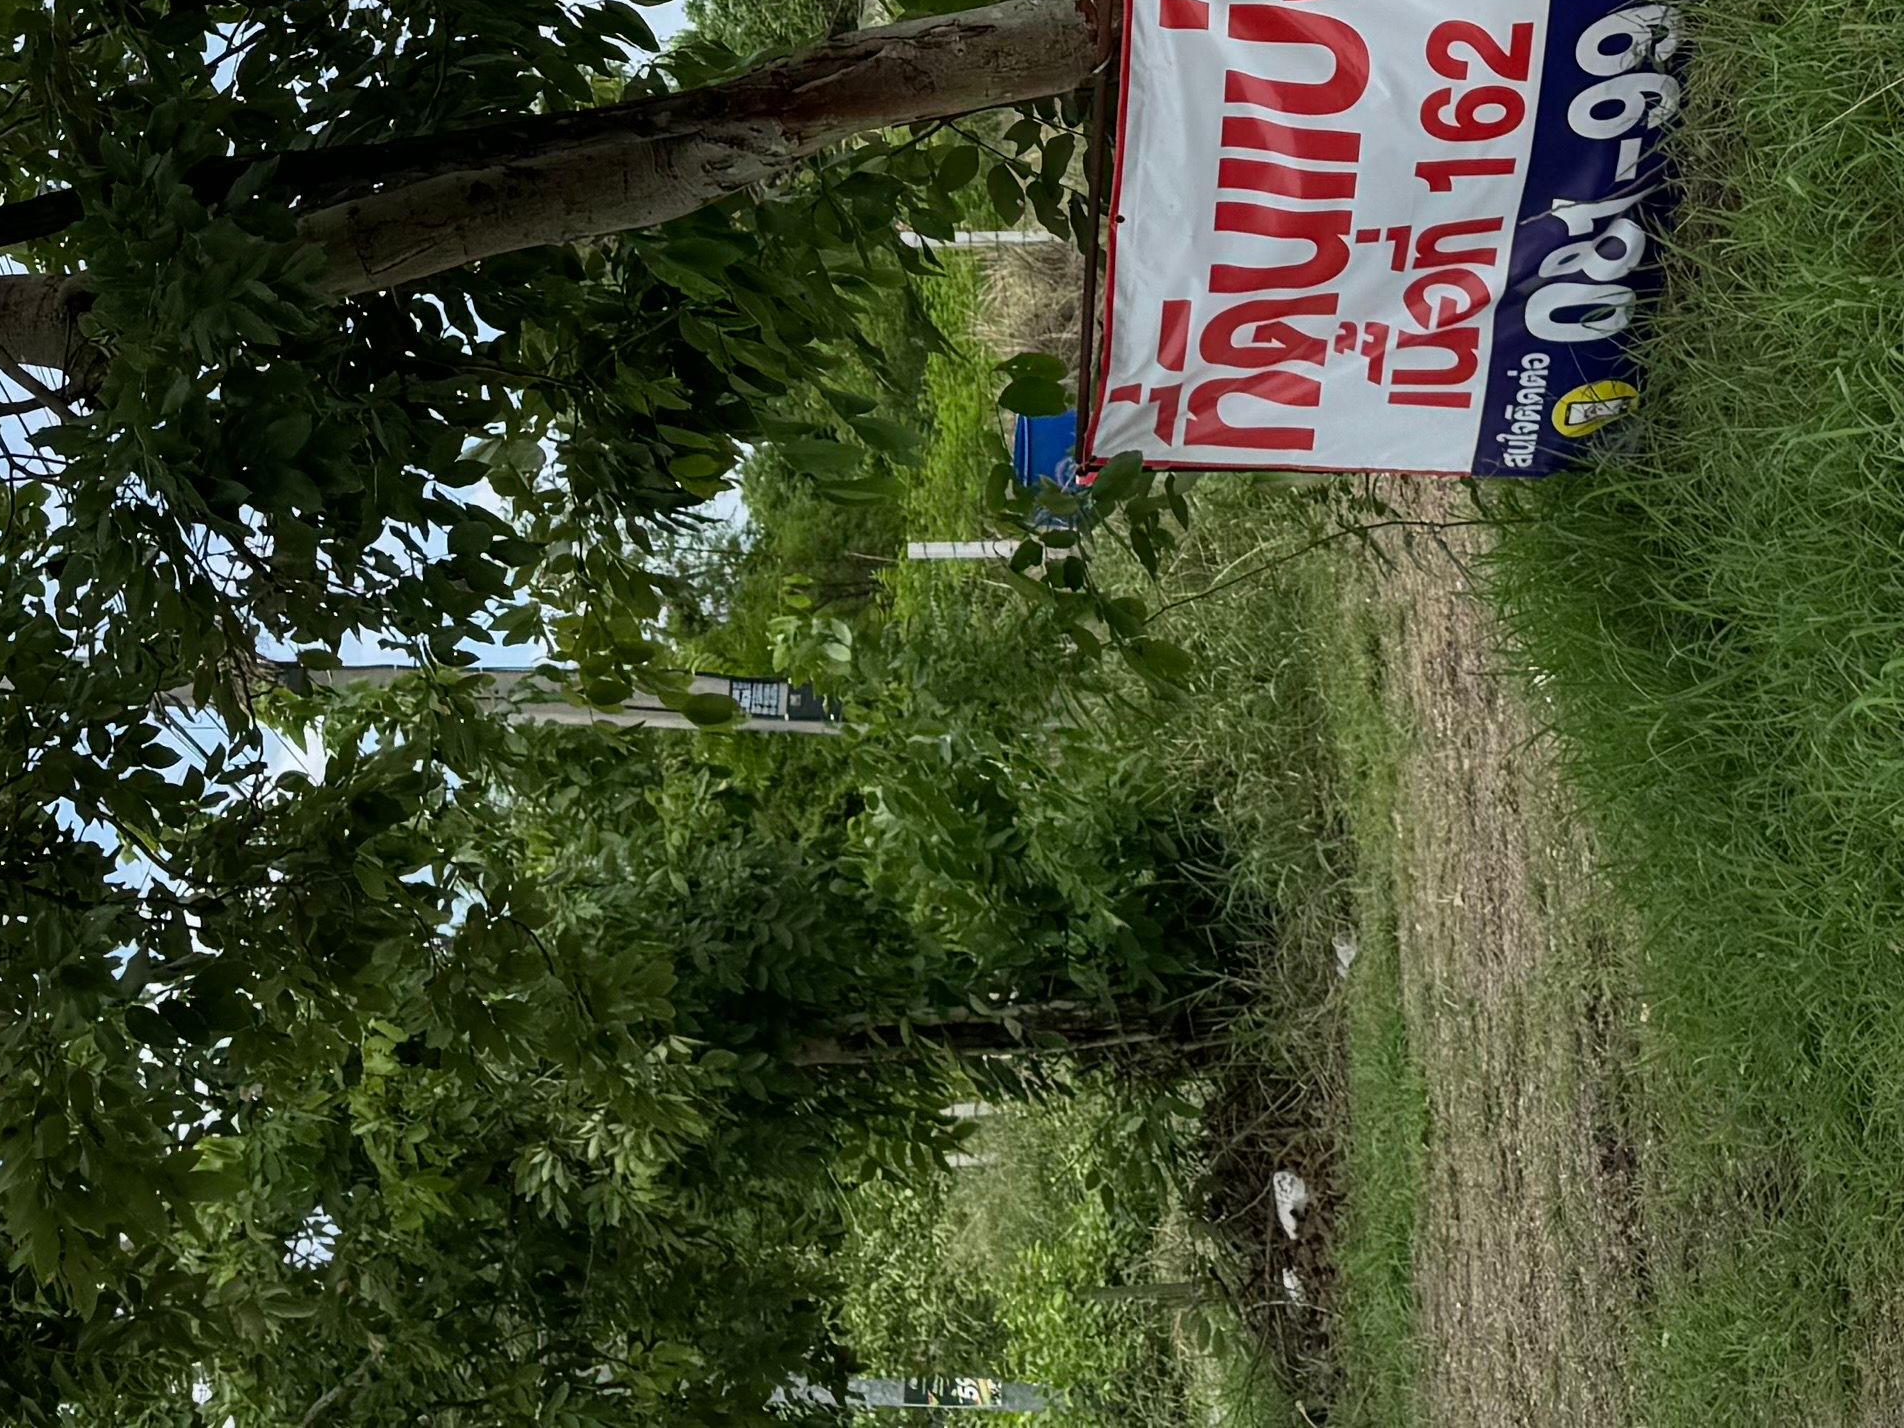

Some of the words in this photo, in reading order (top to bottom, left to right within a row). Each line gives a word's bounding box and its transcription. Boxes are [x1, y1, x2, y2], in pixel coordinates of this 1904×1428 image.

[1414, 18, 1535, 192] 162
[1333, 215, 1504, 408] เนื้อที่
[1495, 351, 1551, 467] สนใจติดต่อ
